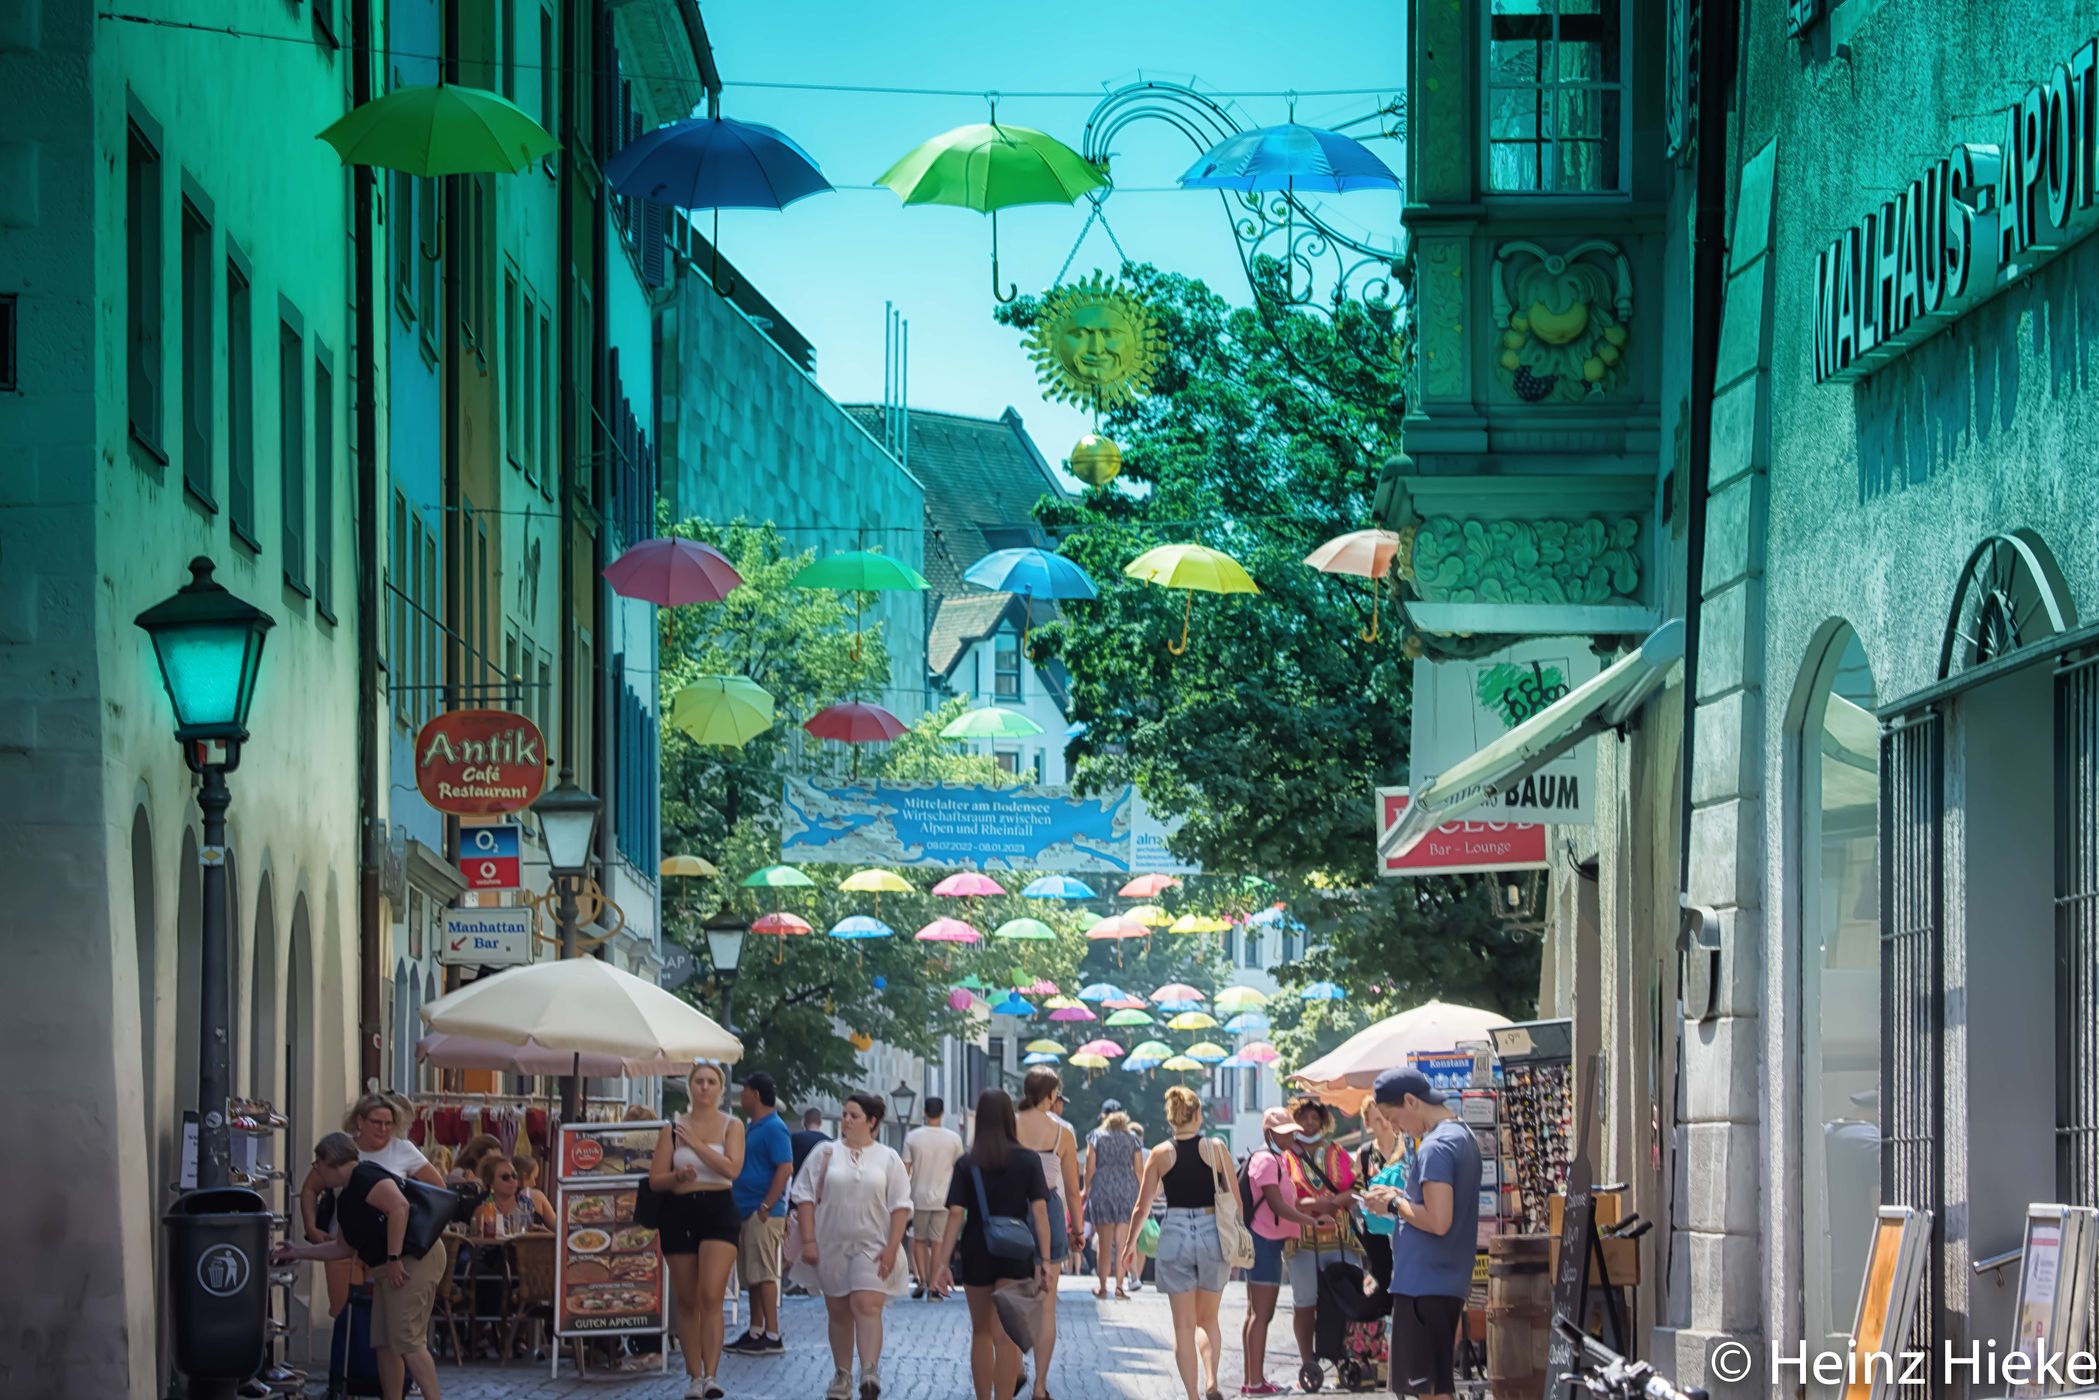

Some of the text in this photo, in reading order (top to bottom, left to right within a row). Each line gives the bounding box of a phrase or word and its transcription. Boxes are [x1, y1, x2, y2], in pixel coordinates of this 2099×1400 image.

[1813, 37, 2099, 384] MALHAUS-APOT
[421, 728, 540, 767] Antik
[462, 765, 500, 784] Café
[438, 782, 528, 800] Restaurant
[1505, 775, 1579, 810] BAUM
[904, 797, 1050, 814] Mittelalter am Bodensee
[902, 810, 1052, 825] Wirtschaftsraum zwischen
[920, 822, 1033, 837] Alpen und Rheinfall
[1429, 842, 1451, 856] Bar
[1465, 841, 1511, 855] Lounge
[448, 921, 525, 935] Manhattan
[474, 937, 499, 950] Bar
[663, 955, 686, 969] AP
[575, 1318, 607, 1329] GUTEN
